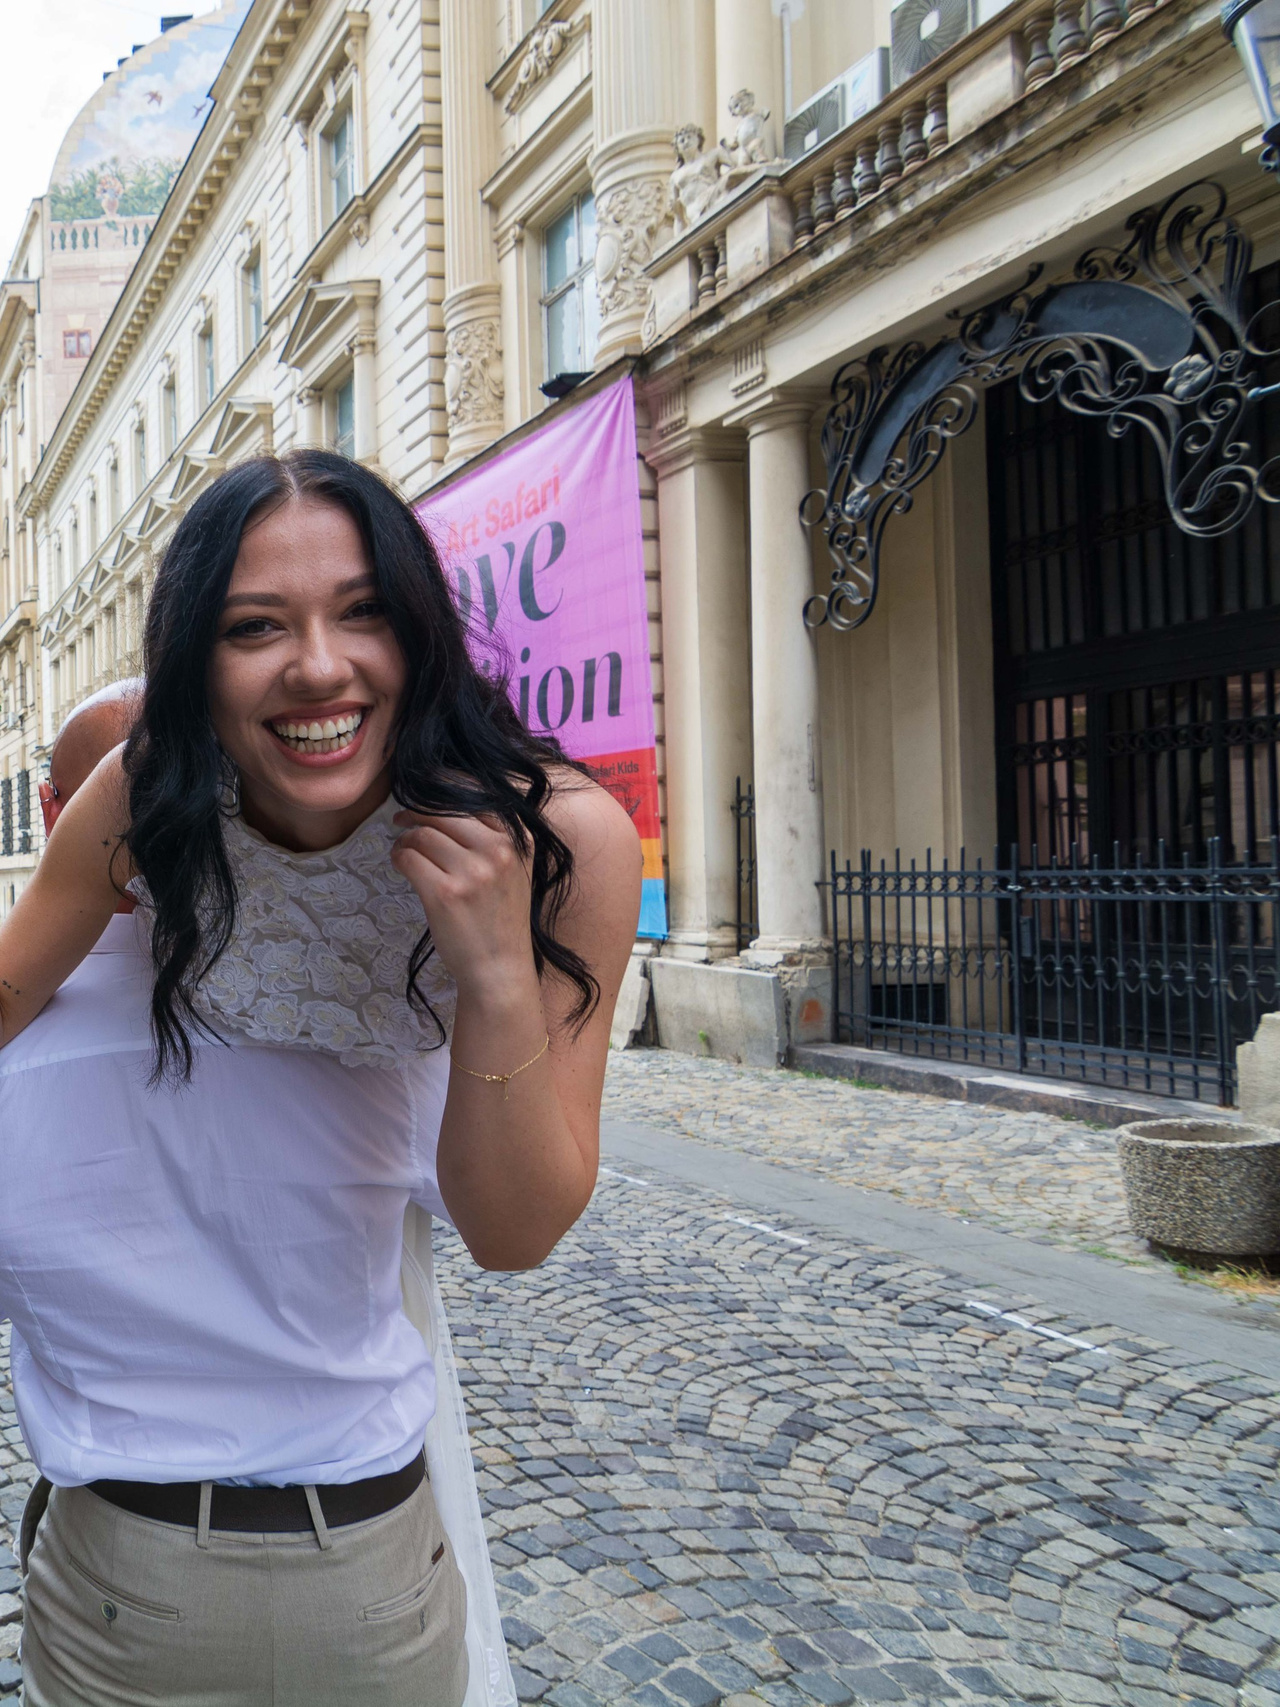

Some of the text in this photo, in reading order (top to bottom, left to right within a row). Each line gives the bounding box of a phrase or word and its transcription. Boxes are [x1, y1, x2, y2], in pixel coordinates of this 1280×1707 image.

[446, 463, 561, 560] Art Safari
[517, 646, 624, 731] ion
[617, 761, 639, 774] Kids
